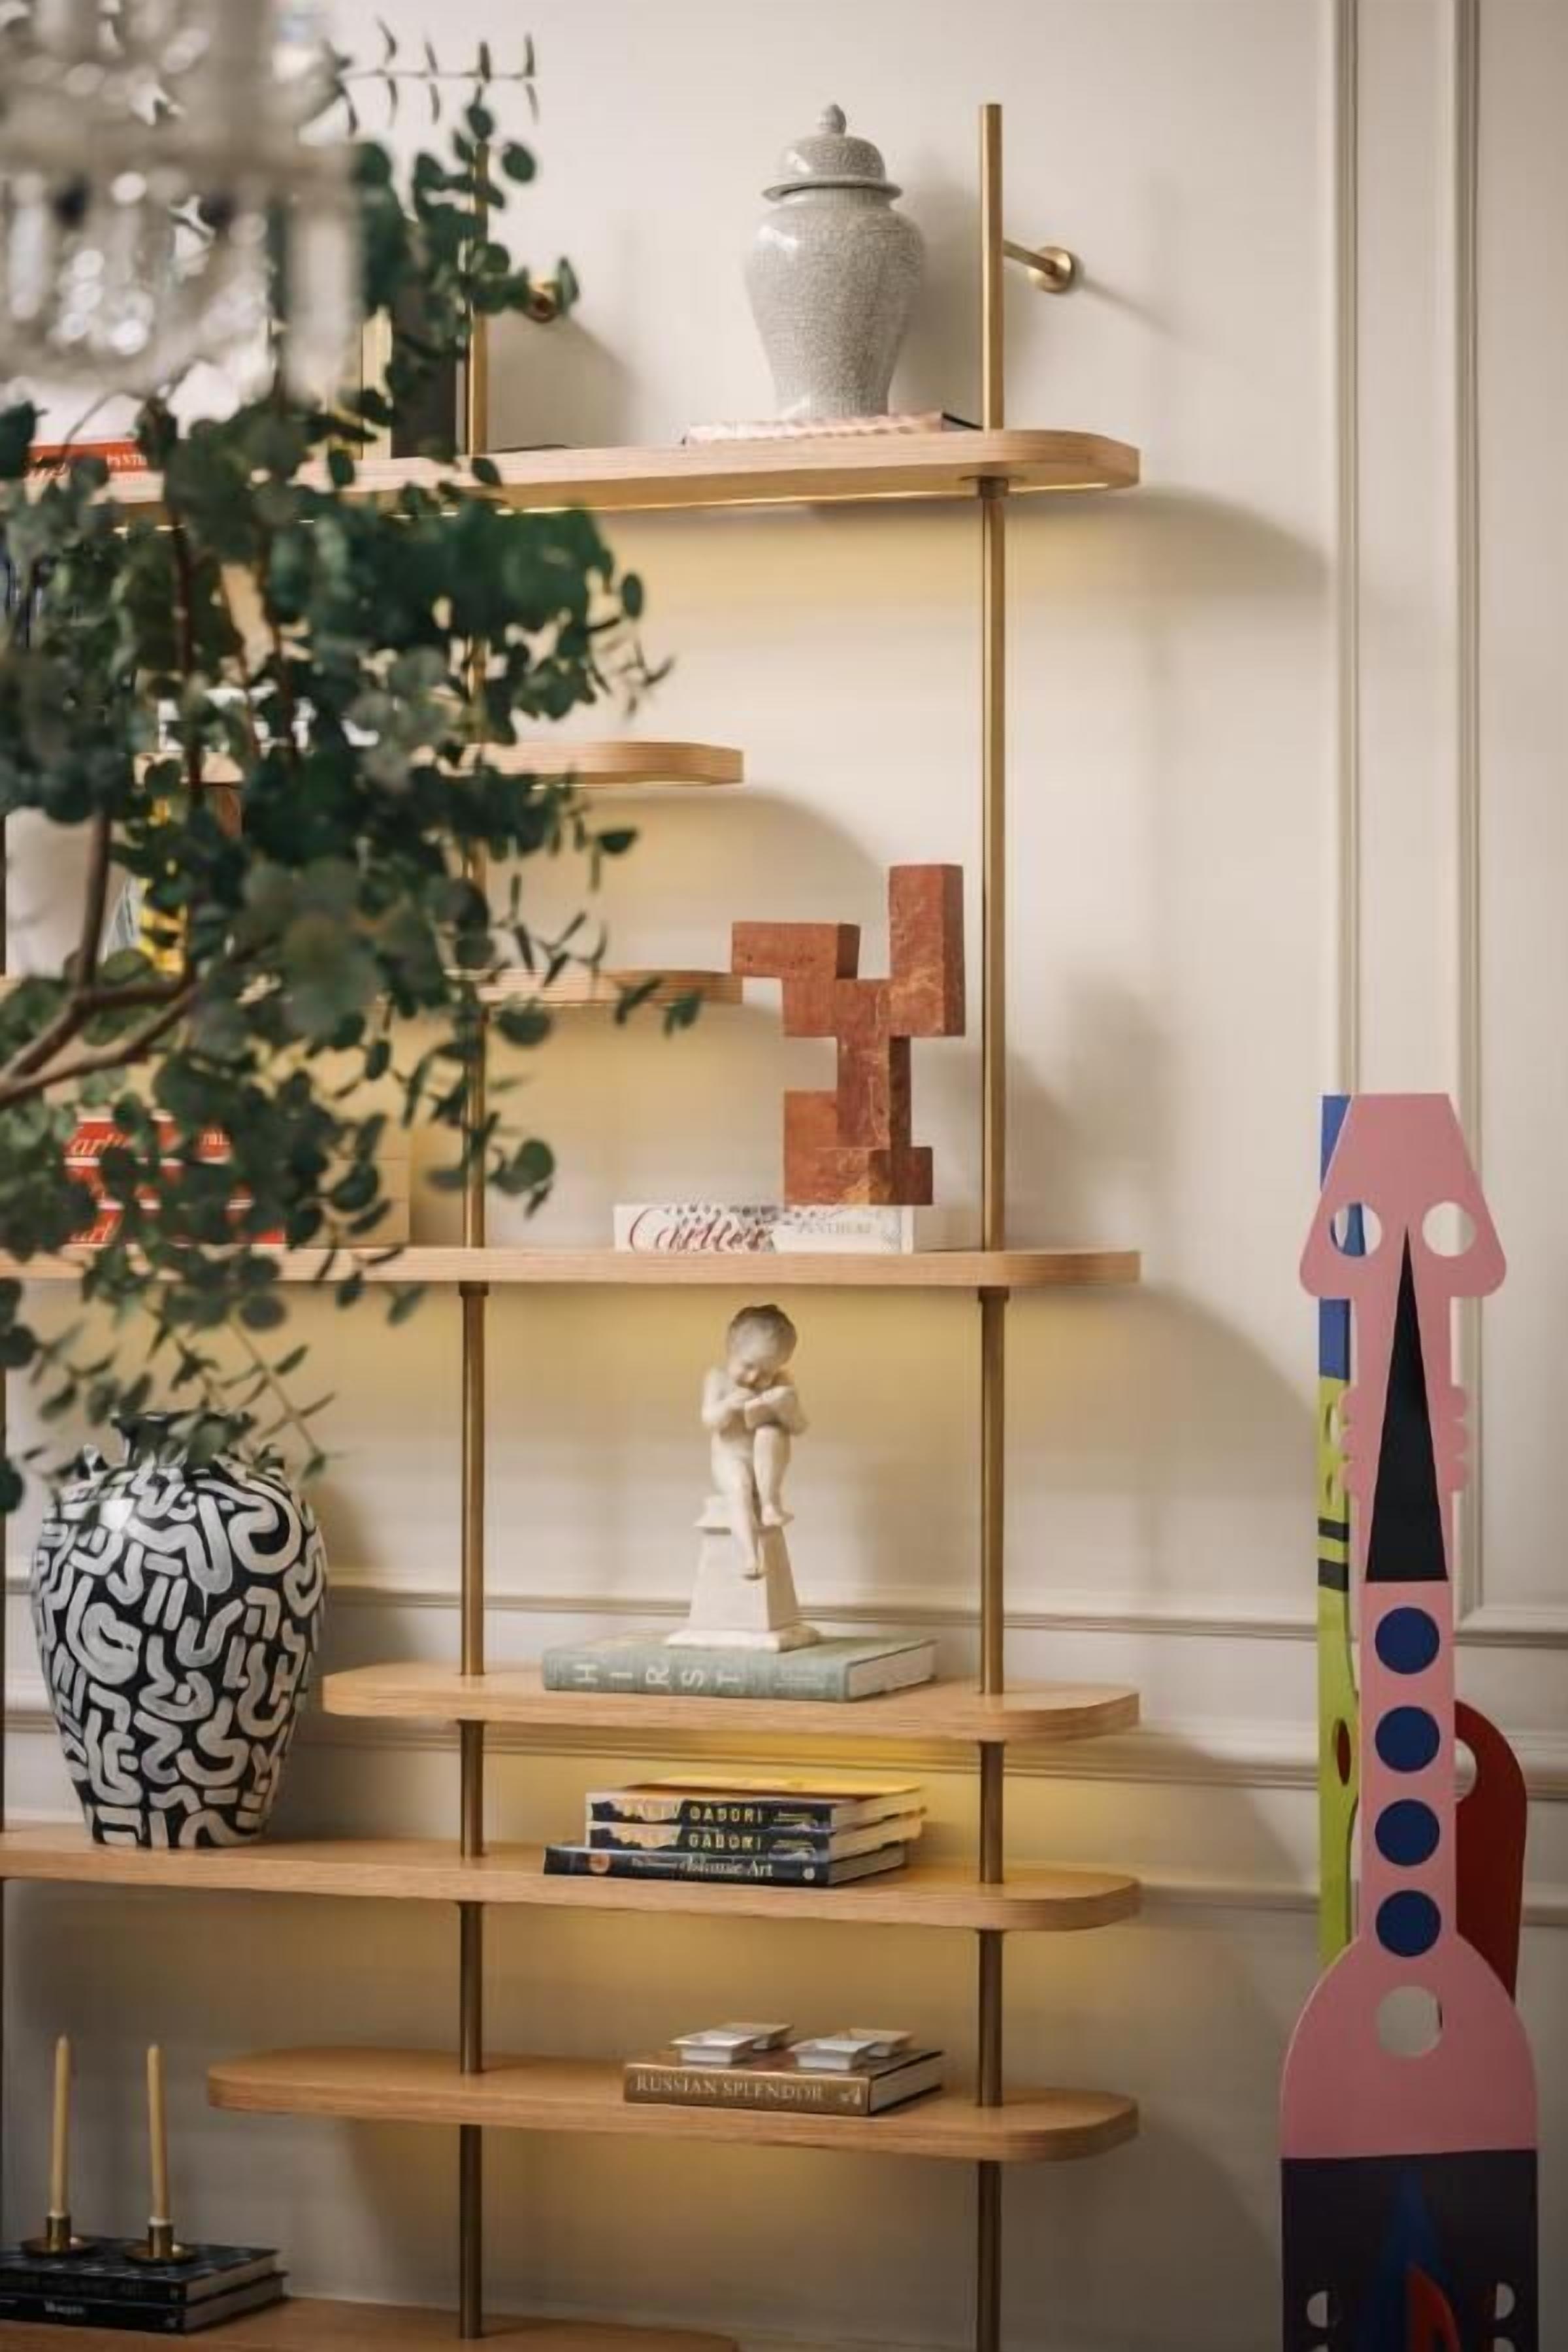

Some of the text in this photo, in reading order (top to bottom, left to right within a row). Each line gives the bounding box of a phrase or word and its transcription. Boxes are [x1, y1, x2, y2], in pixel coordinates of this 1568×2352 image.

[572, 1662, 740, 1688] HIRST
[636, 2074, 822, 2102] RUSSIAN SPLENDOR
